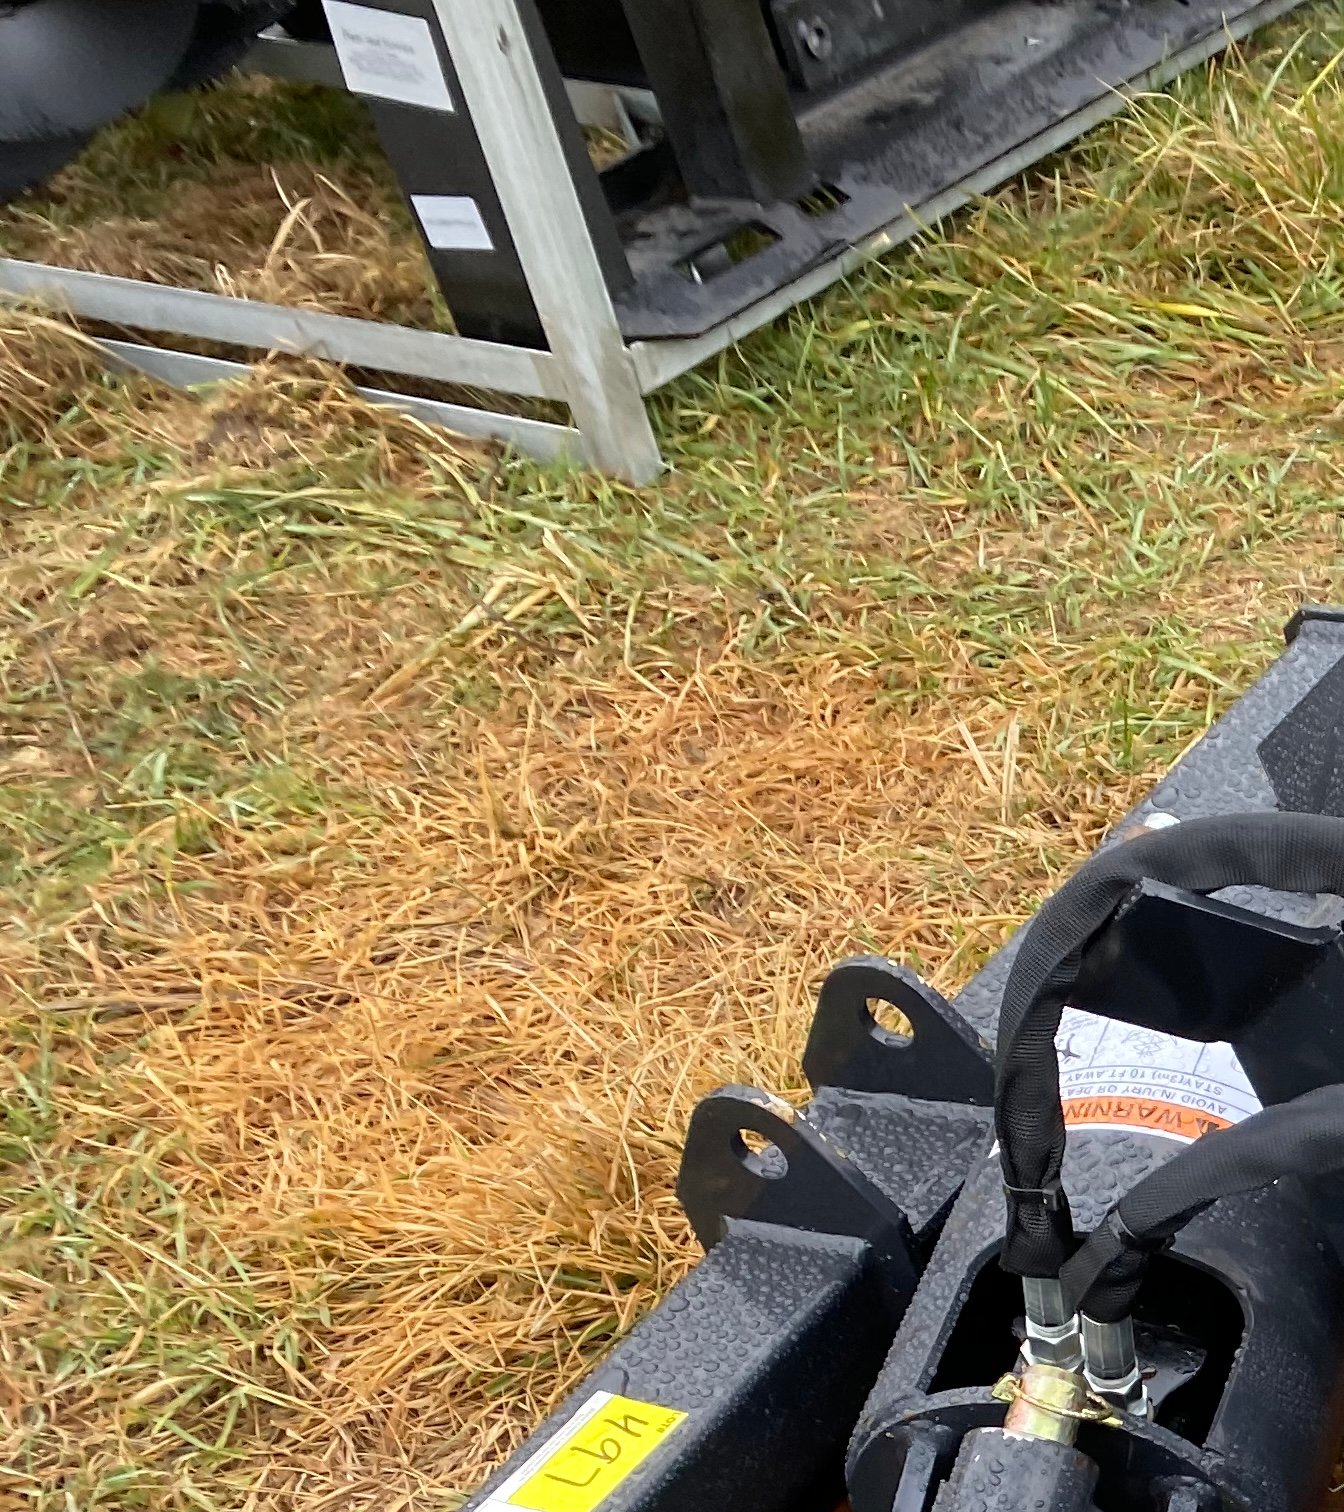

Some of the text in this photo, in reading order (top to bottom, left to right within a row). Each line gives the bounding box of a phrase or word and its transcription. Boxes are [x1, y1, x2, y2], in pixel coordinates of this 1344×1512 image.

[1130, 1069, 1145, 1079] 10
[1063, 1084, 1228, 1115] AVOID INJURY OR DEA
[1065, 1101, 1182, 1129] WARNIN
[544, 1413, 650, 1487] 497
